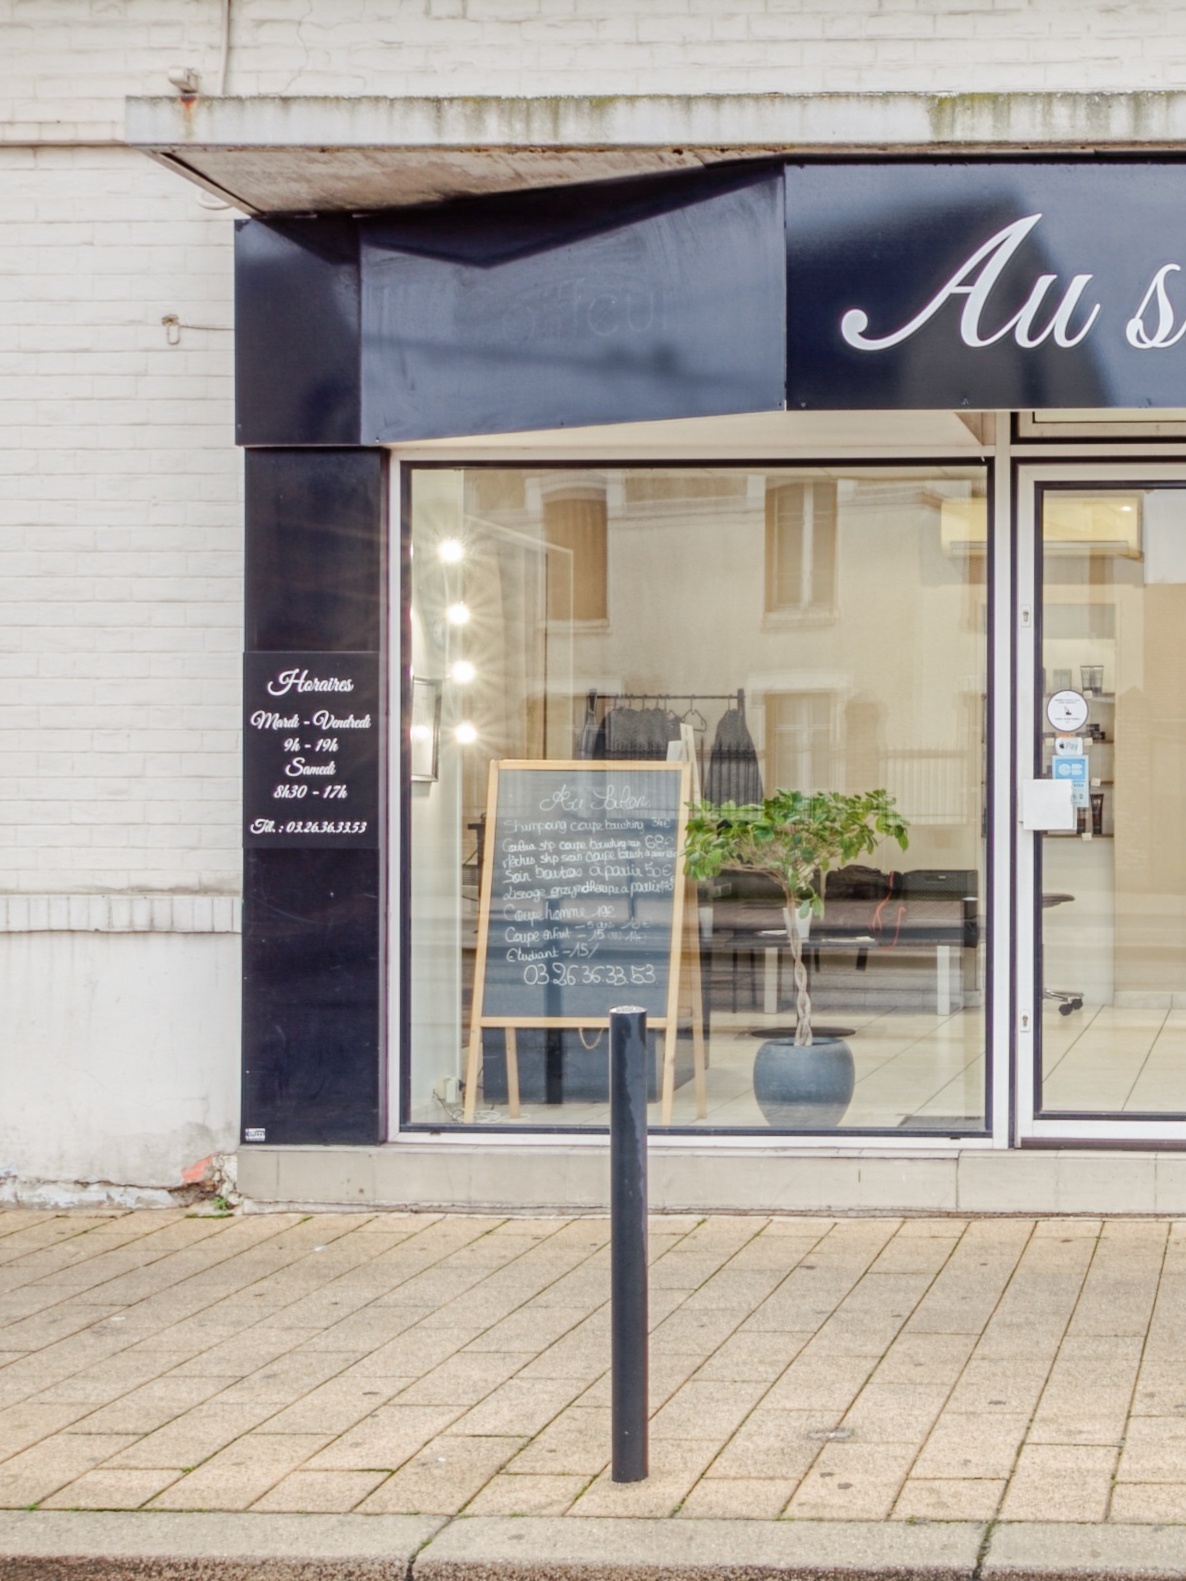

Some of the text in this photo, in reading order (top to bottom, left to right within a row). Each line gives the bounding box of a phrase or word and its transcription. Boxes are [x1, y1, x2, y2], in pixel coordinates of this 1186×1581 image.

[839, 212, 1101, 351] Au
[267, 668, 354, 696] Horaires
[250, 710, 299, 731] Mardi
[312, 710, 371, 731] Vendredi
[283, 737, 301, 752] 9h
[314, 737, 339, 752] 19h
[285, 757, 336, 777] Samedi
[273, 784, 308, 799] 8h30
[322, 784, 348, 799] 17h
